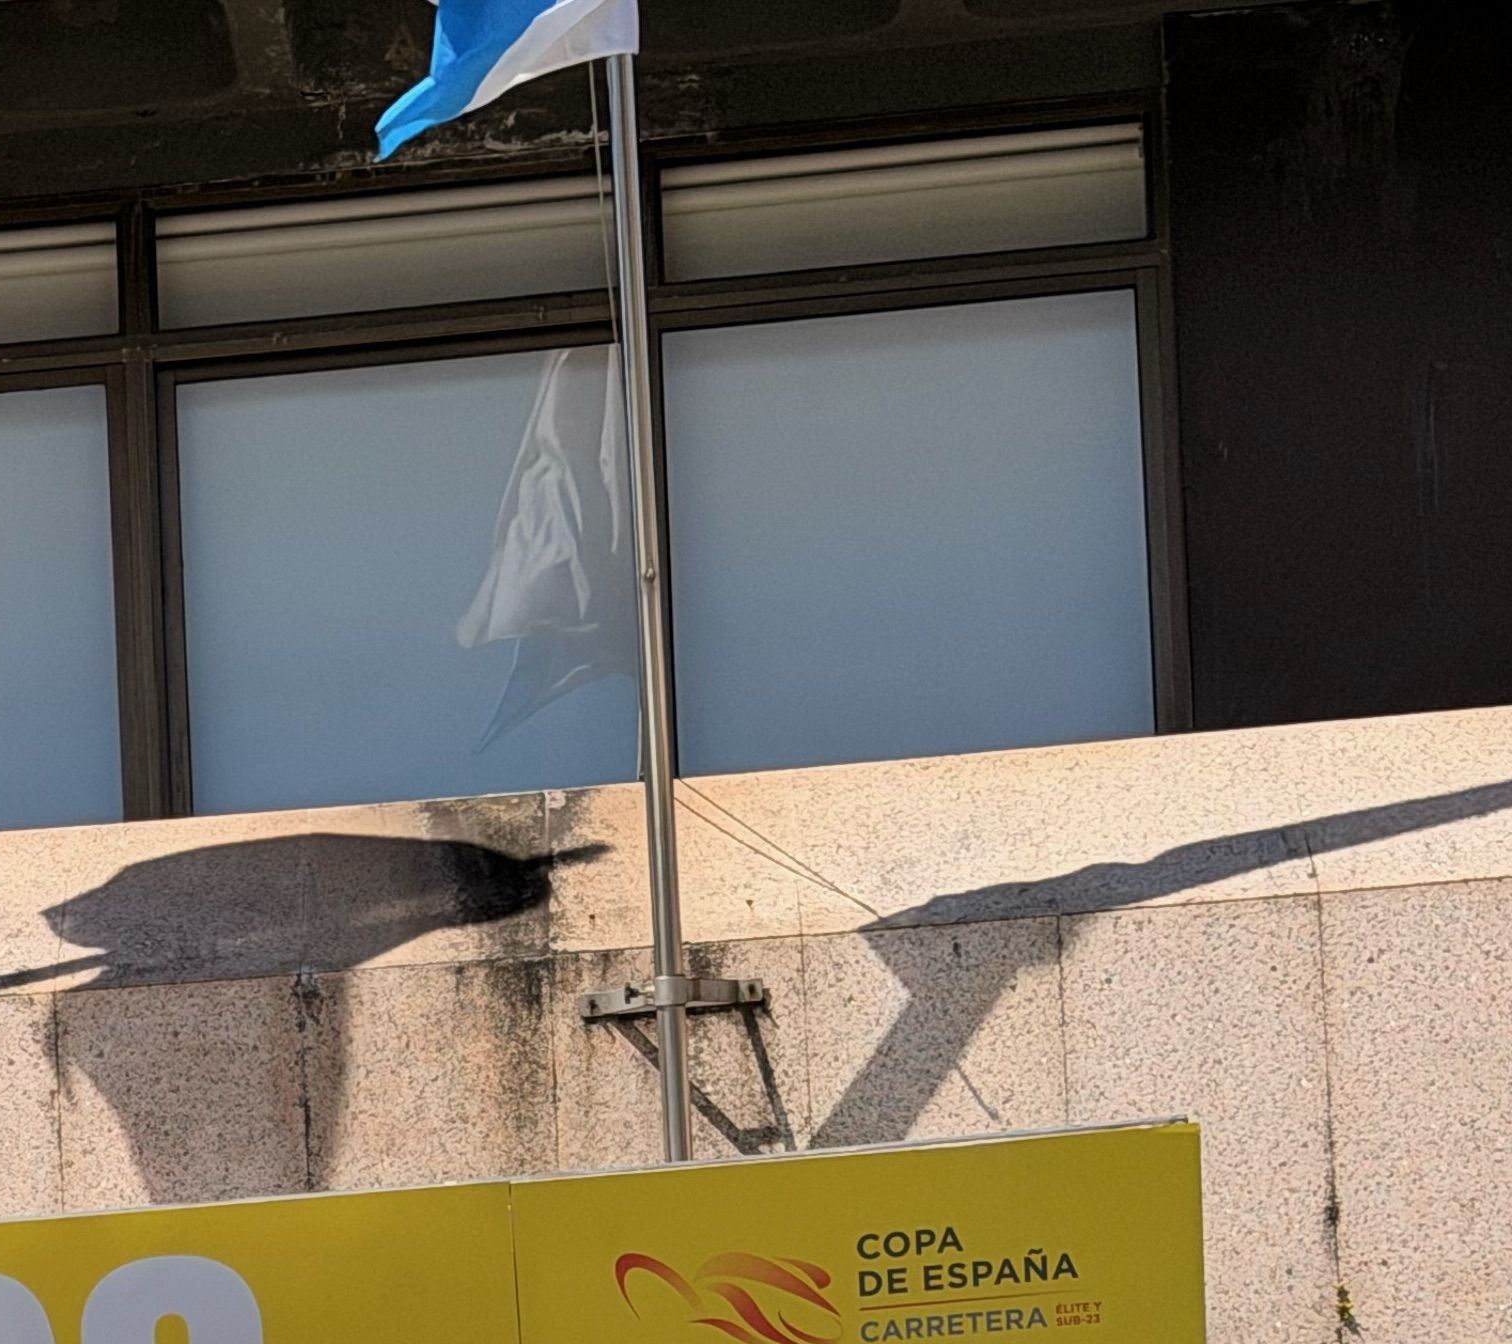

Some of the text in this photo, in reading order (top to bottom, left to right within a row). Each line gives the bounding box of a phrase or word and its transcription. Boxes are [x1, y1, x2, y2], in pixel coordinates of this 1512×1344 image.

[856, 1227, 963, 1260] COPA
[859, 1248, 1079, 1297] DE ESPAÑA
[860, 1307, 1047, 1344] CARRETERA
[1056, 1313, 1101, 1327] SUB-23
